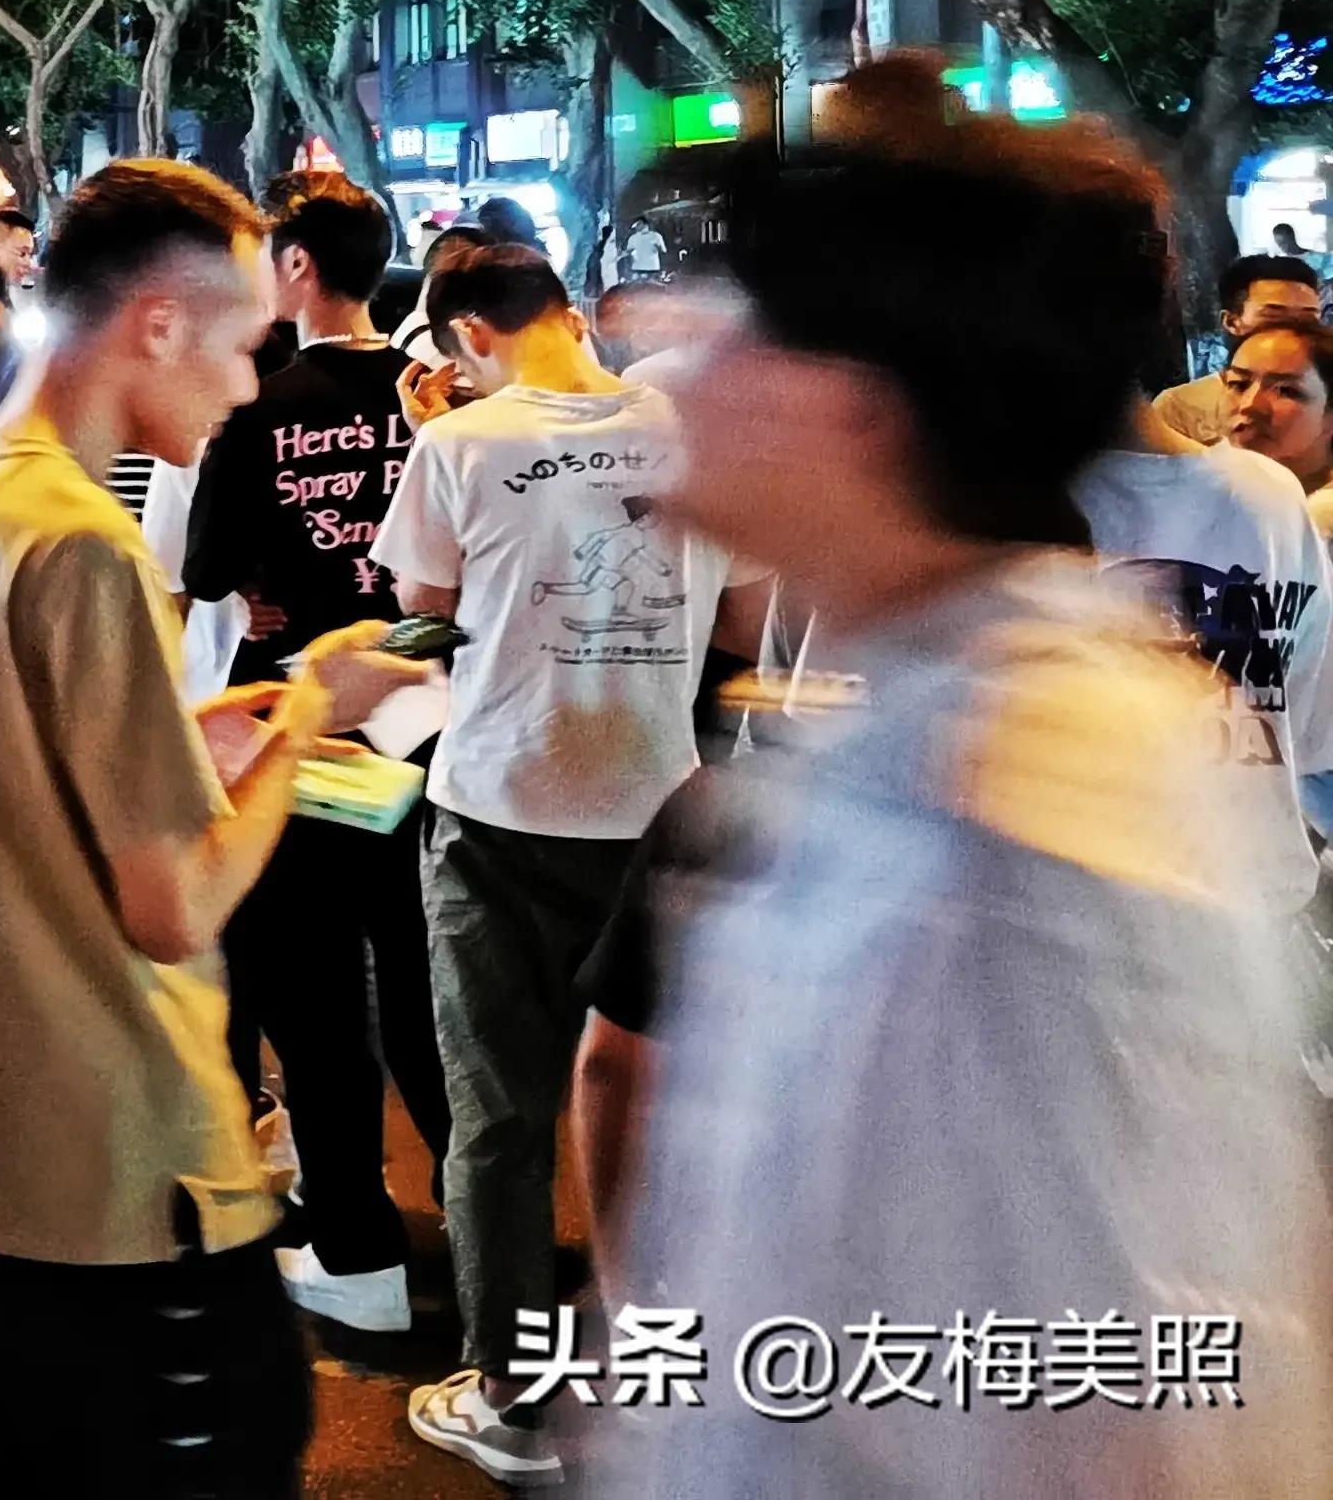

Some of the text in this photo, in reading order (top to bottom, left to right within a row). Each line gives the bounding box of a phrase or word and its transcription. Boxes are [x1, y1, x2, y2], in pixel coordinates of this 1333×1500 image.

[272, 414, 416, 463] Here's L
[275, 459, 406, 506] Spray P
[503, 451, 670, 494] いのちのせ
